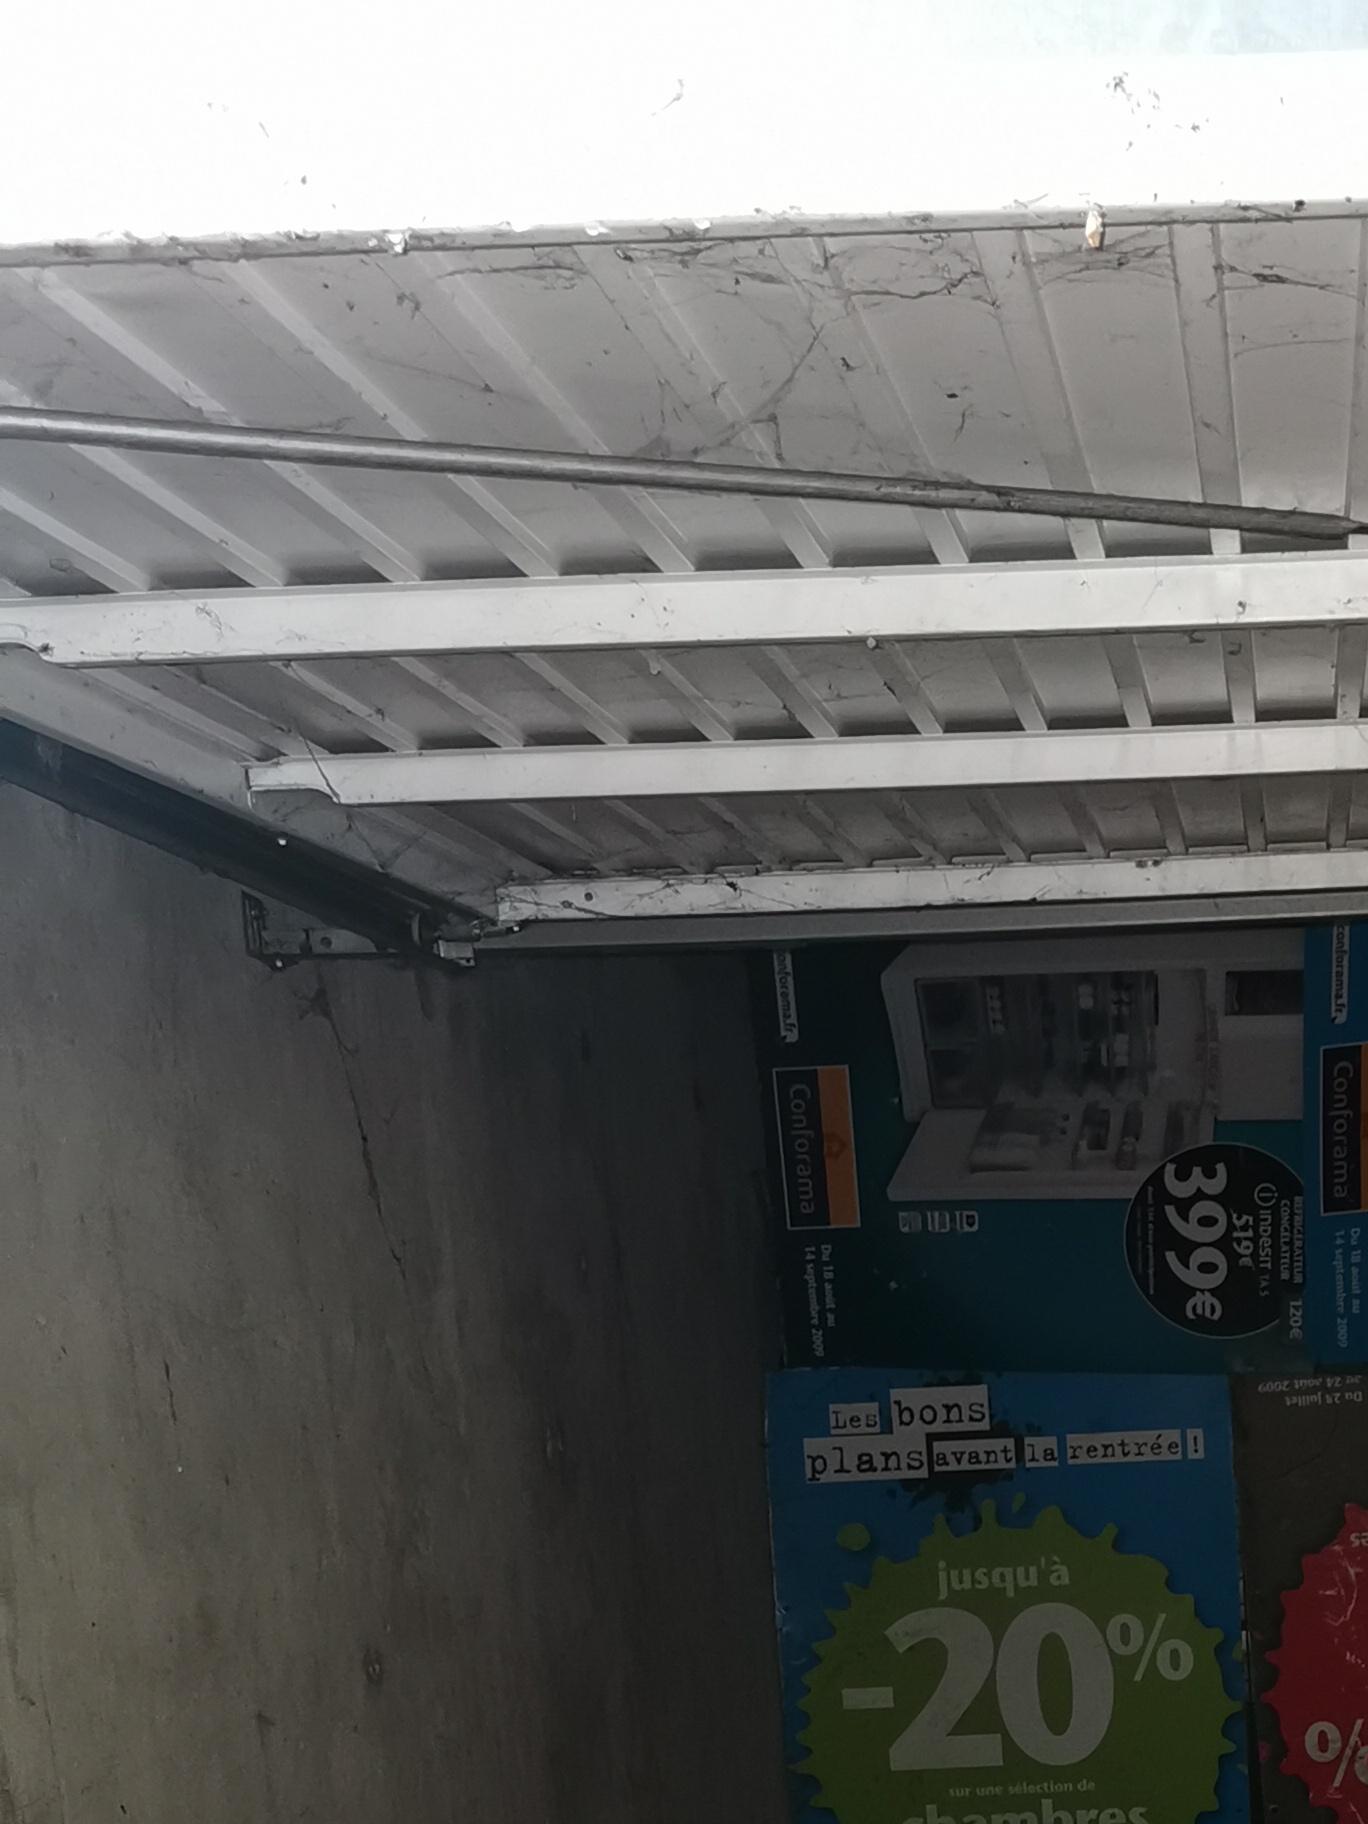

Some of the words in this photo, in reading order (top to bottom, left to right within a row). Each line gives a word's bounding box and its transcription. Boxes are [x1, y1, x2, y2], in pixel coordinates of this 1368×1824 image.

[778, 950, 796, 1032] onforama.fr
[1332, 1060, 1353, 1199] Conforama
[789, 1083, 816, 1215] Conforama
[1163, 1161, 1228, 1321] 399€
[1229, 1207, 1256, 1271] 519€
[1350, 1226, 1361, 1246] Du
[804, 1246, 817, 1261] 14
[820, 1244, 833, 1261] Du
[1350, 1249, 1361, 1263] 18
[822, 1265, 835, 1280] 18
[1332, 1248, 1346, 1314] septembre
[803, 1263, 820, 1325] septembre
[1288, 1298, 1304, 1342] 120€
[1336, 1316, 1348, 1348] 2009
[811, 1327, 825, 1357] 2009
[1257, 1380, 1291, 1393] 2009
[1284, 1391, 1322, 1407] juillet
[1345, 1391, 1363, 1403] Du
[830, 1409, 879, 1430] Les
[893, 1399, 988, 1428] bons
[805, 1444, 926, 1481] plans
[934, 1442, 1014, 1467] avant
[1026, 1441, 1058, 1463] la
[1069, 1433, 1181, 1461] rentrée
[1191, 1434, 1200, 1454] !
[937, 1556, 1071, 1601] jusqu'à
[840, 1601, 1196, 1772] -20%
[948, 1785, 971, 1797] sur
[976, 1784, 1003, 1796] une
[1008, 1779, 1073, 1794] sélection
[1077, 1778, 1096, 1792] de
